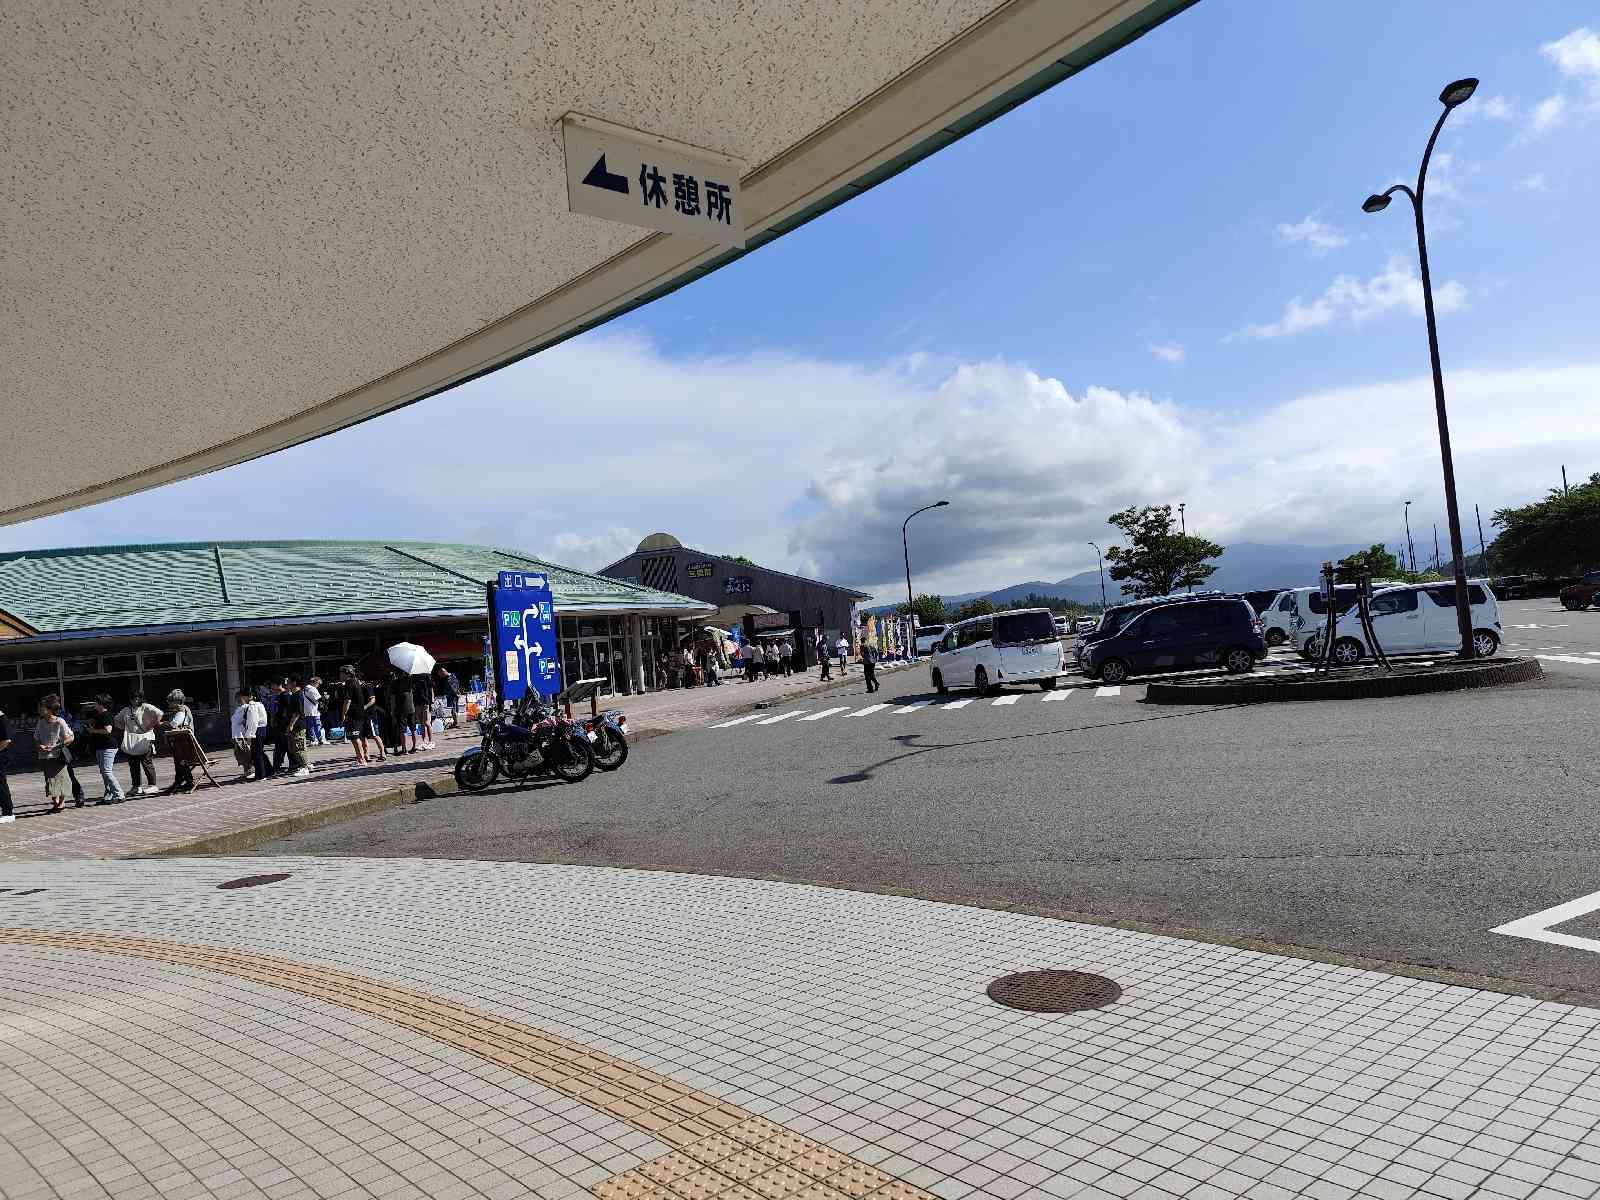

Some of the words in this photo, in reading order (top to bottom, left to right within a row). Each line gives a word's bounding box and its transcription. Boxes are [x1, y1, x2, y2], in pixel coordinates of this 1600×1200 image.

[639, 163, 732, 225] 休憩所
[504, 574, 522, 588] 出口
[503, 613, 509, 626] P
